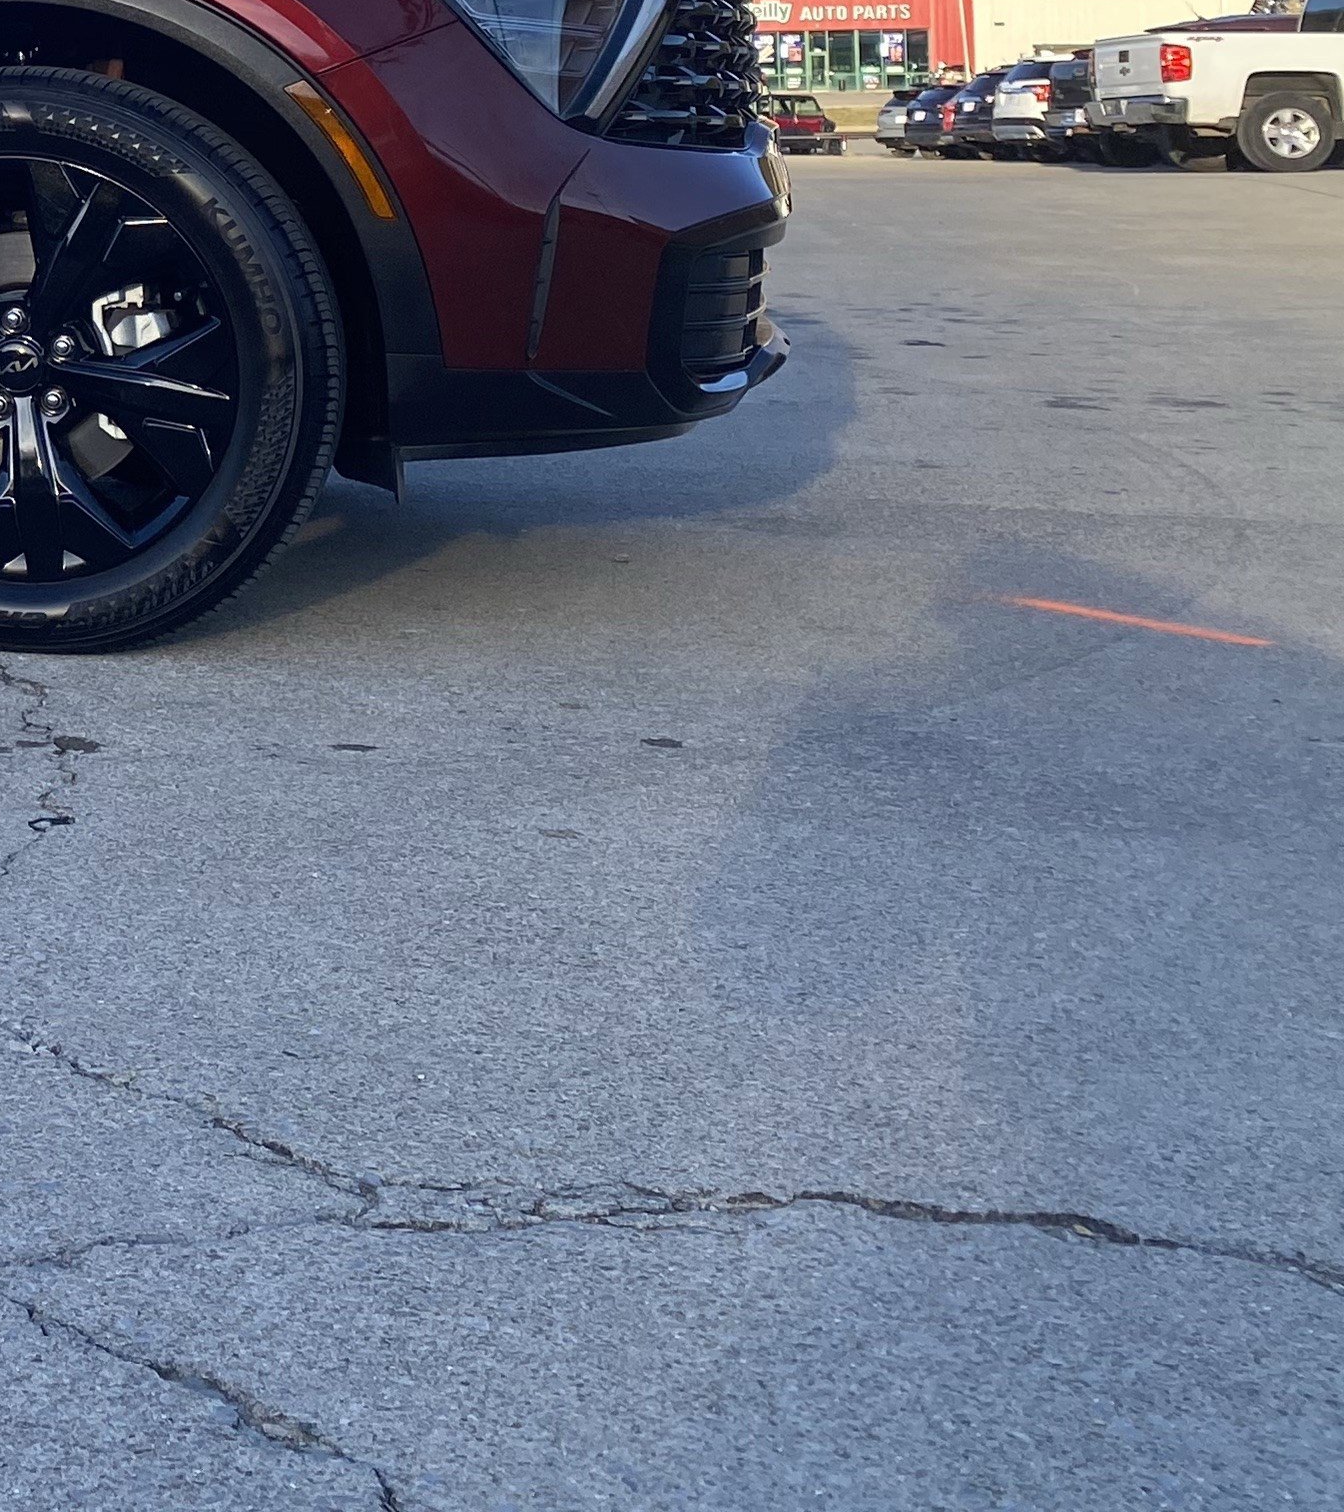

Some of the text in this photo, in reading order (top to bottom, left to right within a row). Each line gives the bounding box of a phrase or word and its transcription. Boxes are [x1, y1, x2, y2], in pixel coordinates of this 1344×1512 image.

[751, 0, 911, 23] eilly AUTO PARTS
[201, 196, 283, 337] KUMHO
